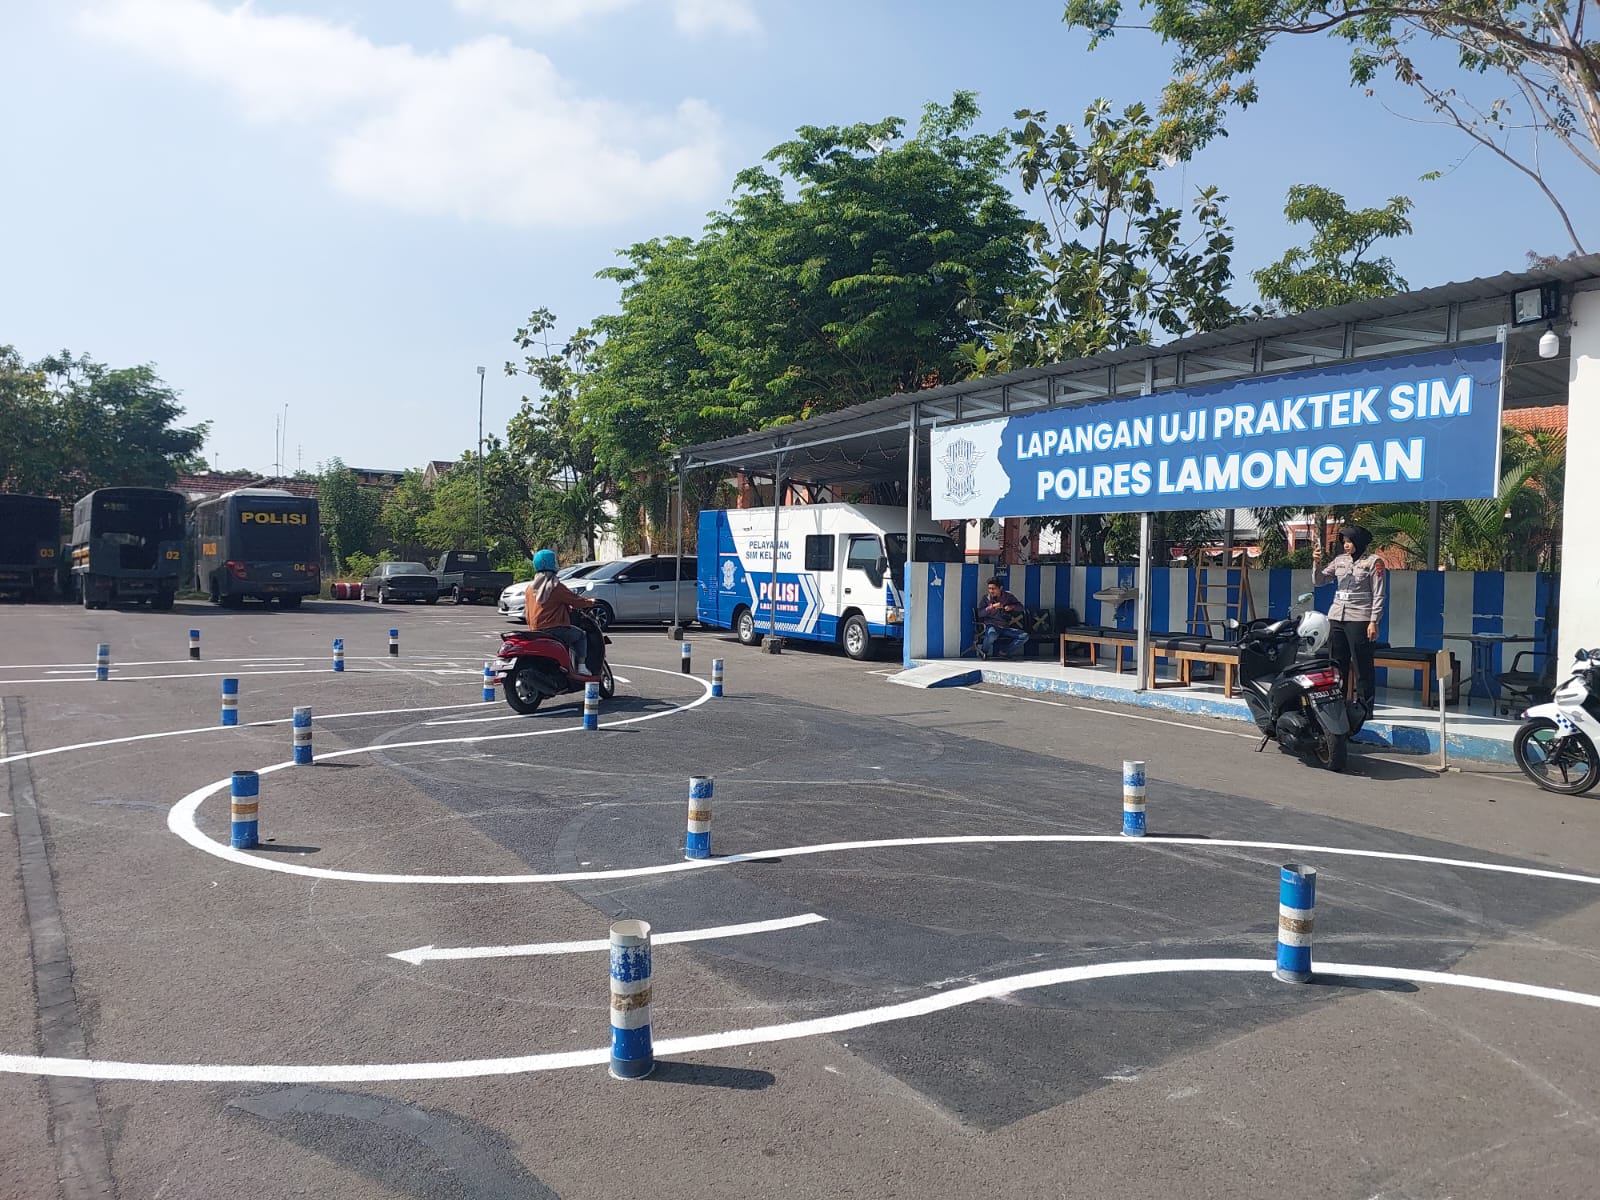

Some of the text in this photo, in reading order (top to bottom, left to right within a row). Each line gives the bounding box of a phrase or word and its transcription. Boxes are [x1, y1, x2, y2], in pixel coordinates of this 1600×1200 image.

[1016, 377, 1471, 459] LAPANGAN UJI PRAKTEK SIM
[1036, 438, 1424, 501] POLRES LAMONGAN
[241, 511, 307, 525] POLISI
[749, 540, 789, 549] PELAYAAN
[40, 548, 54, 558] 03
[166, 551, 180, 560] 02
[745, 551, 792, 560] SIM KELLING
[293, 563, 305, 571] 04
[759, 582, 800, 603] POLISI
[776, 603, 799, 612] LINTAS
